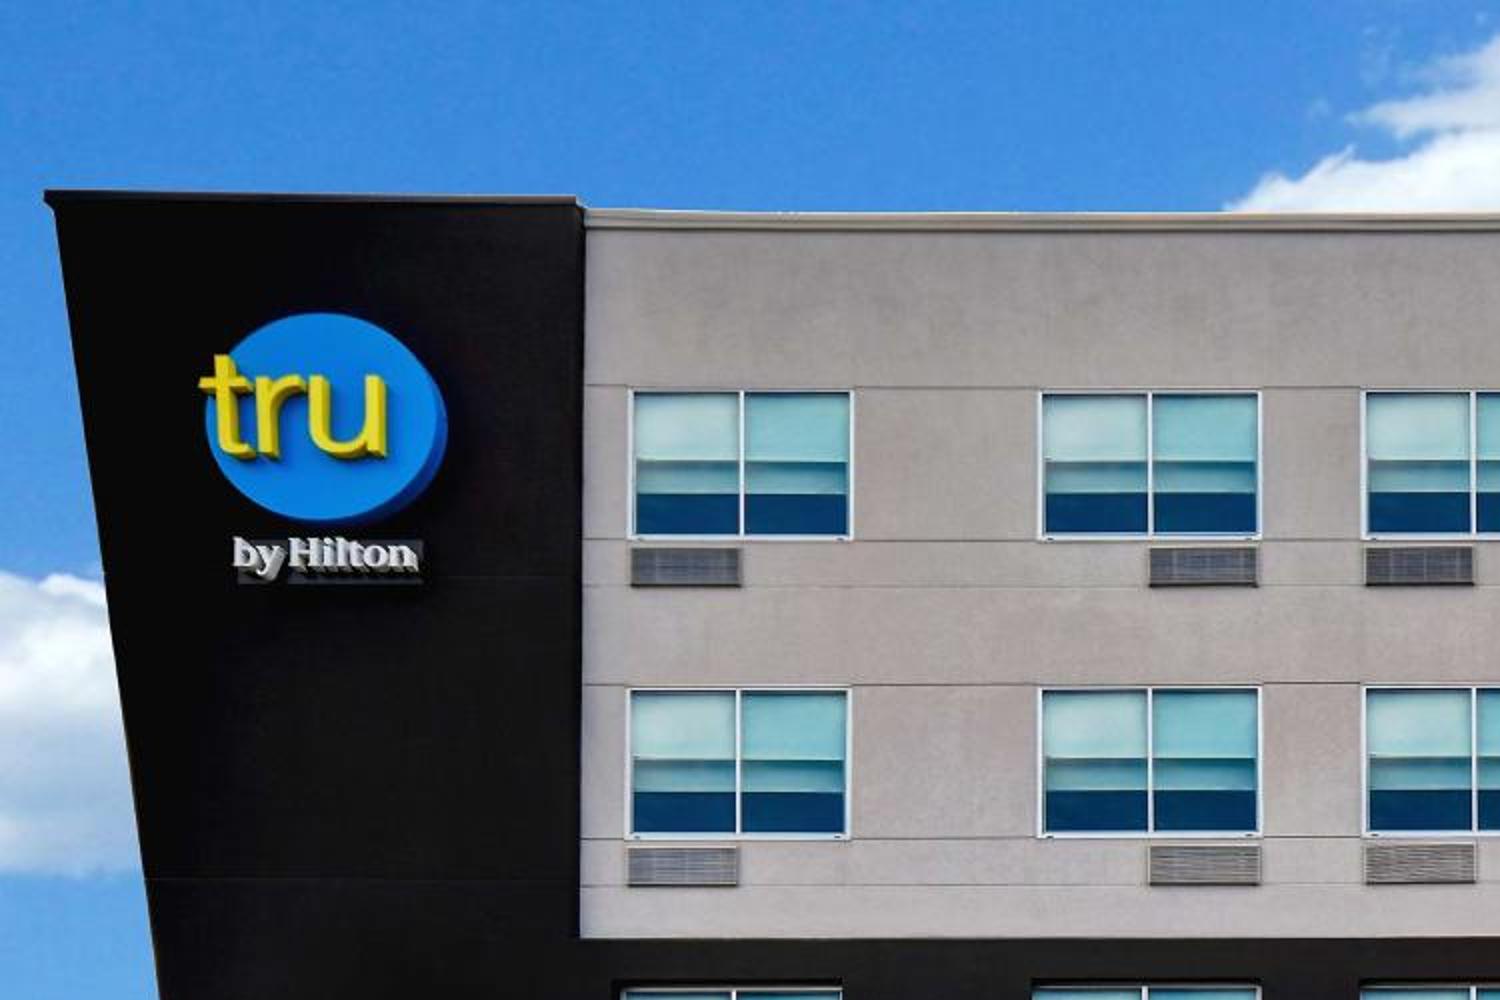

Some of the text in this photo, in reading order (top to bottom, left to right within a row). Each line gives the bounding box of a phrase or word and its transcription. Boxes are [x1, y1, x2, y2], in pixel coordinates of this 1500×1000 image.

[198, 353, 389, 461] tru
[232, 536, 420, 581] by Hilton
